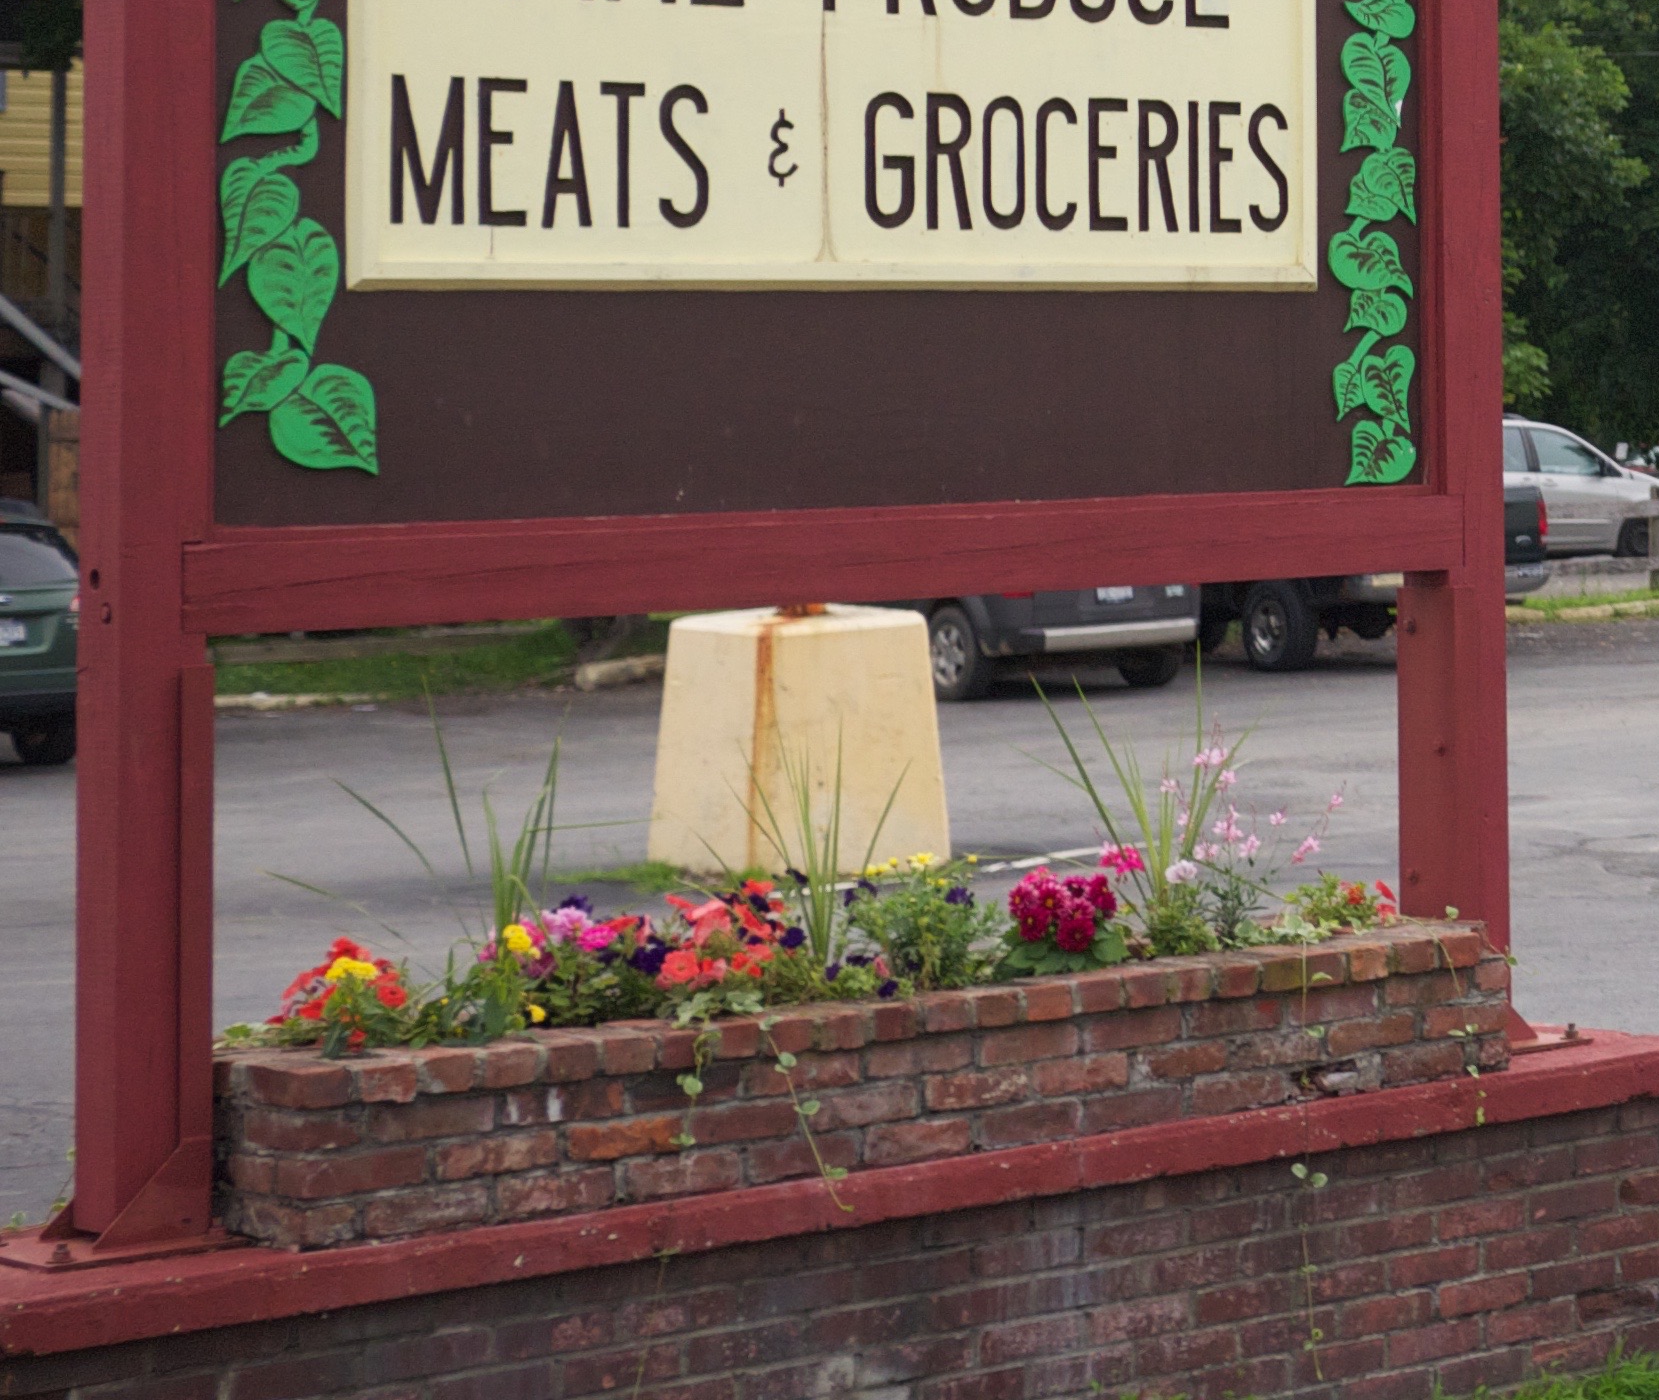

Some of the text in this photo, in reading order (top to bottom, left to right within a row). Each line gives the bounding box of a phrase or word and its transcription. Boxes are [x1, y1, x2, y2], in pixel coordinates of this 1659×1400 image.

[389, 72, 1289, 234] MEATS & GROCERIES
